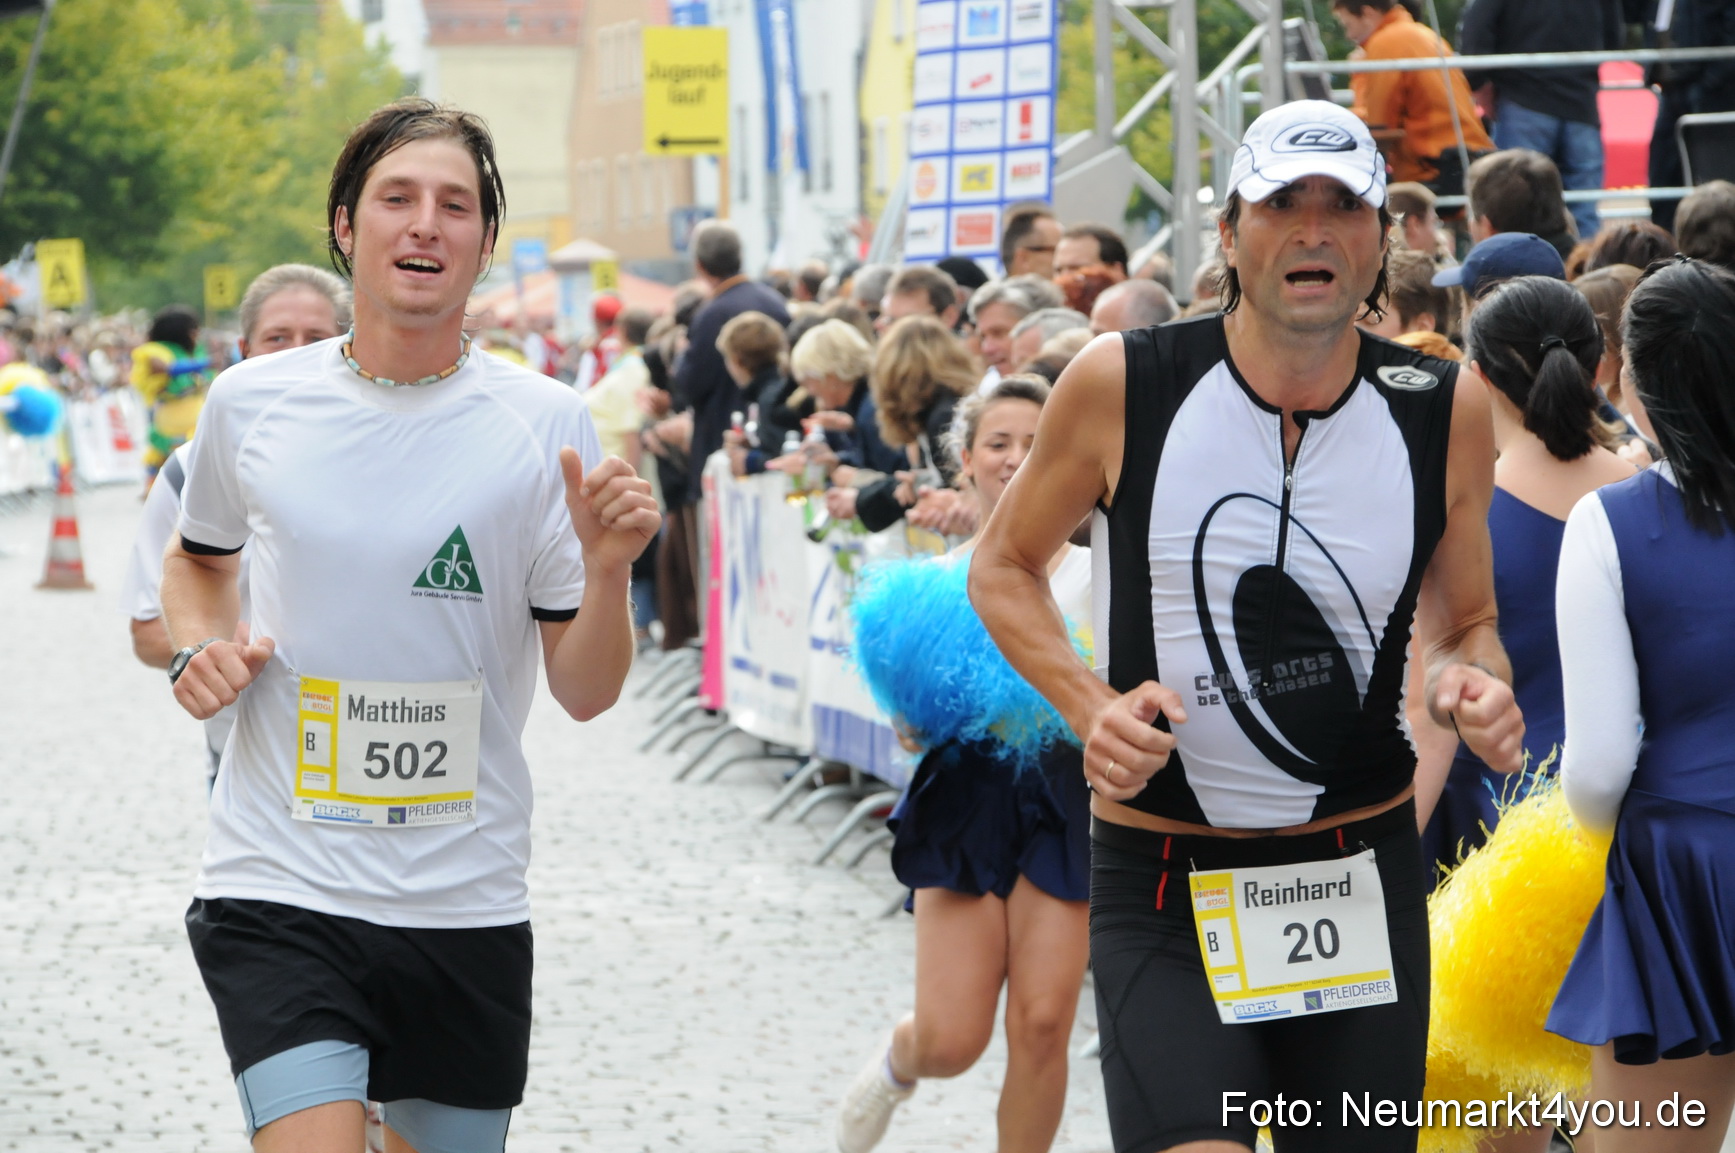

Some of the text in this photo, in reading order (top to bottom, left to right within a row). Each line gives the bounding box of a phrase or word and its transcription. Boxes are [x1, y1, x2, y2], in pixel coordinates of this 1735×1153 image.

[645, 60, 726, 82] Jugend-
[1247, 652, 1334, 686] sorts
[347, 694, 446, 724] Matthias
[305, 732, 316, 751] B
[363, 740, 448, 780] 502
[313, 804, 361, 818] BOCK
[408, 801, 473, 817] PFLEIDERER
[1244, 872, 1351, 908] Reinhard
[1206, 931, 1220, 952] B
[1283, 918, 1340, 965] 20
[1323, 980, 1392, 1001] PFLEIDERER
[1325, 994, 1394, 1008] AKTIENGESELLSCHAFT
[1233, 1000, 1278, 1015] BOCK
